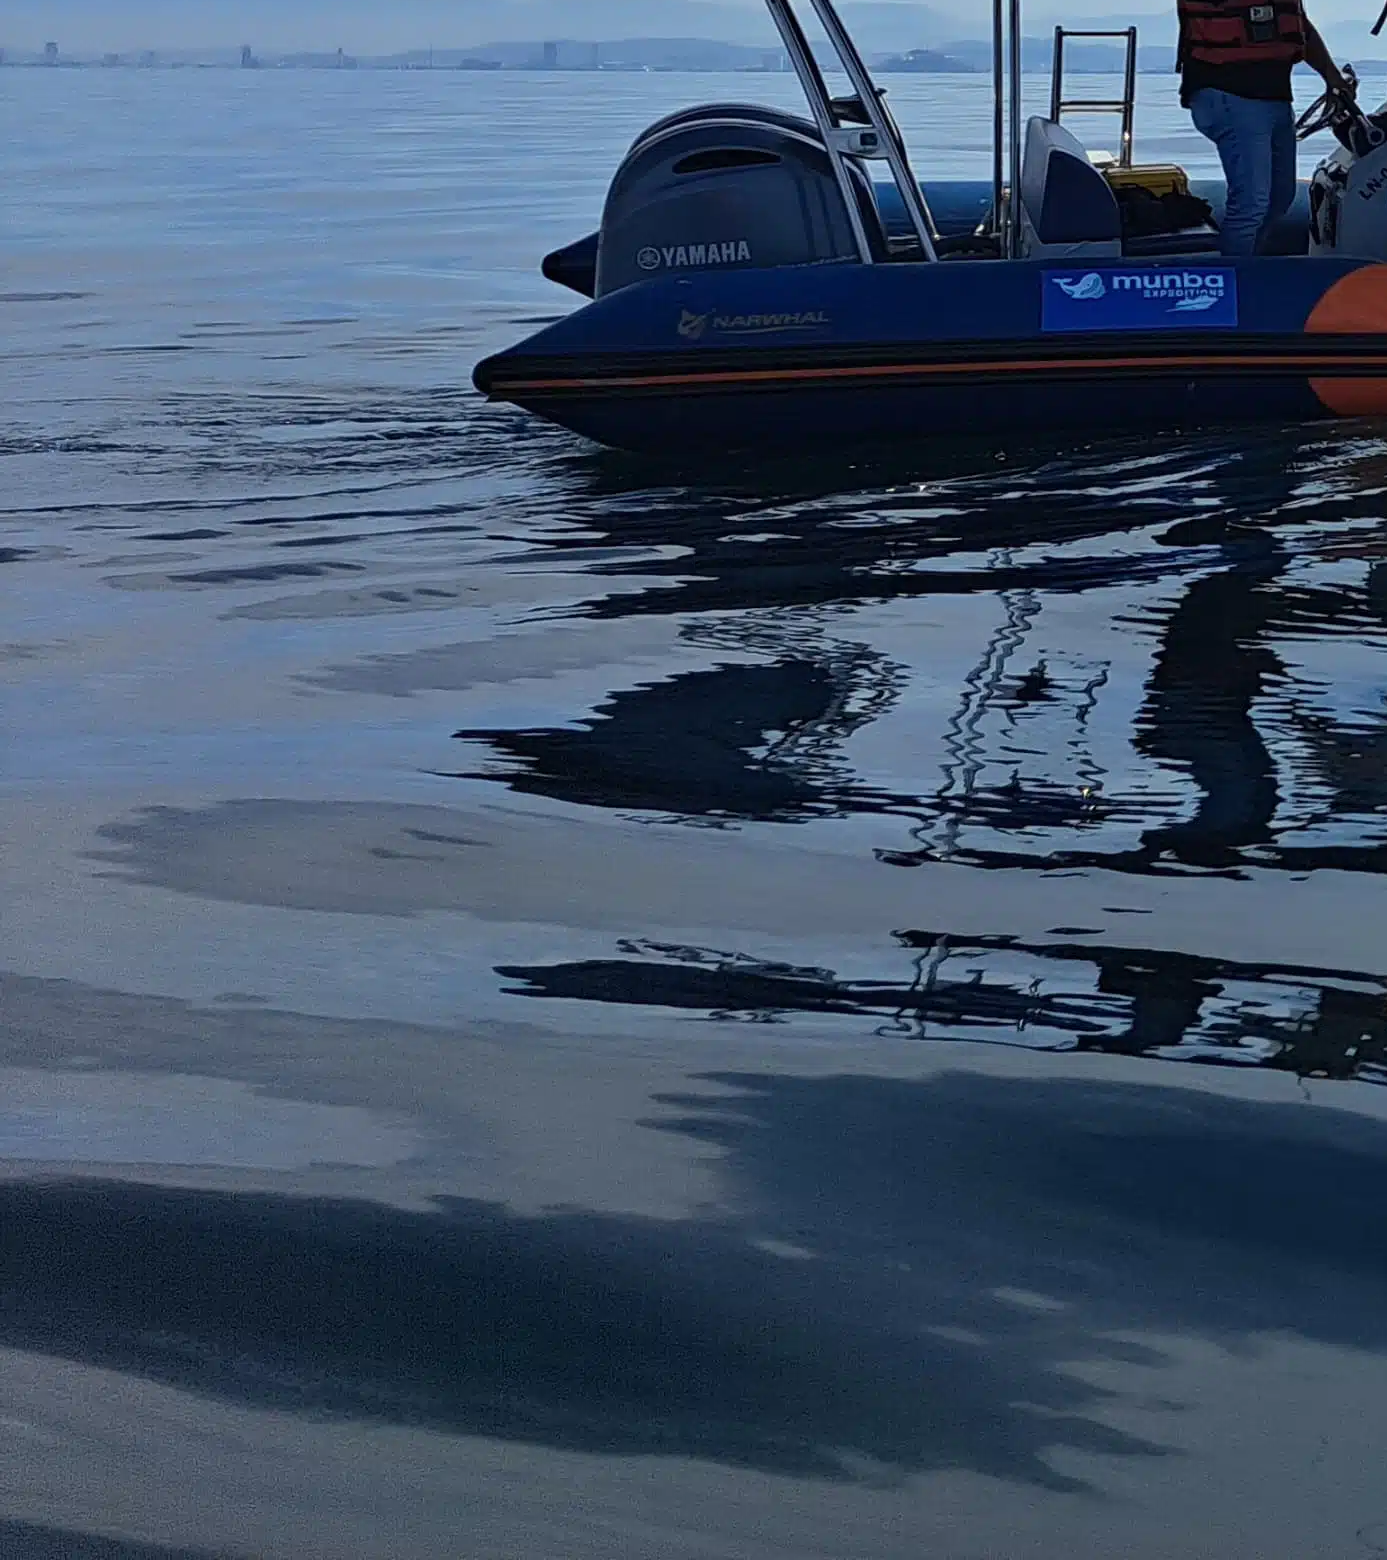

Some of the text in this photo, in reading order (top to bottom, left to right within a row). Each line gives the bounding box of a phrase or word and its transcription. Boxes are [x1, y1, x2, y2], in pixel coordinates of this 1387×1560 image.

[661, 240, 751, 267] YAMAHA
[1112, 272, 1225, 289] munba
[1143, 289, 1225, 298] EXPEDITIONS
[712, 310, 829, 328] NARWHAL
